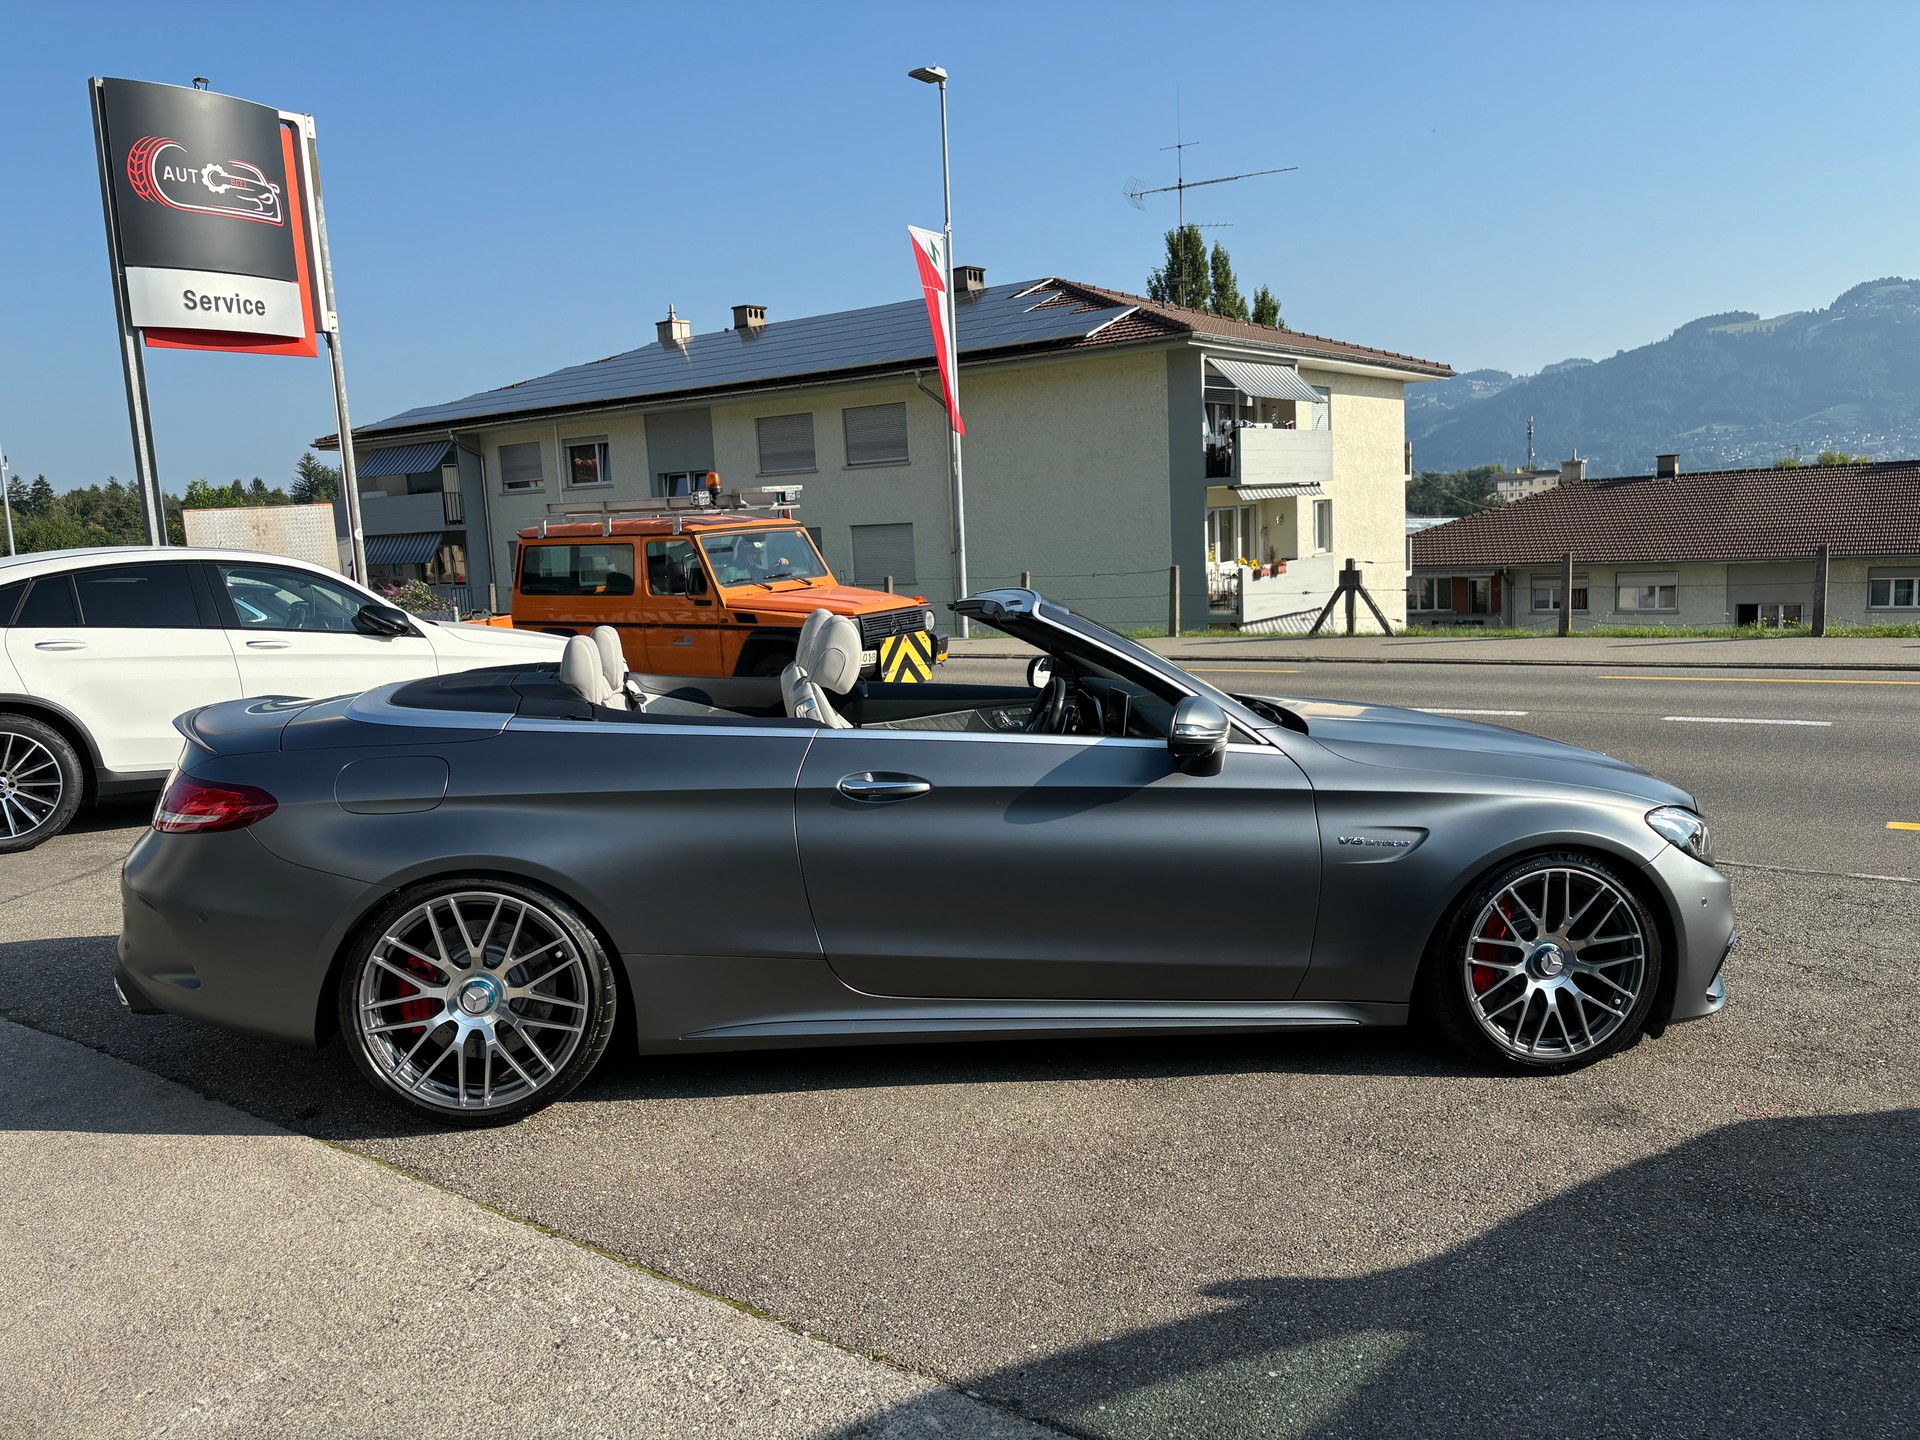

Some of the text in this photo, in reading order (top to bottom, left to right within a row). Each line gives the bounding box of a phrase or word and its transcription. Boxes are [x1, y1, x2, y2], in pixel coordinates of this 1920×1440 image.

[183, 289, 266, 316] Service
[861, 652, 877, 663] 018
[1337, 836, 1365, 846] V8
